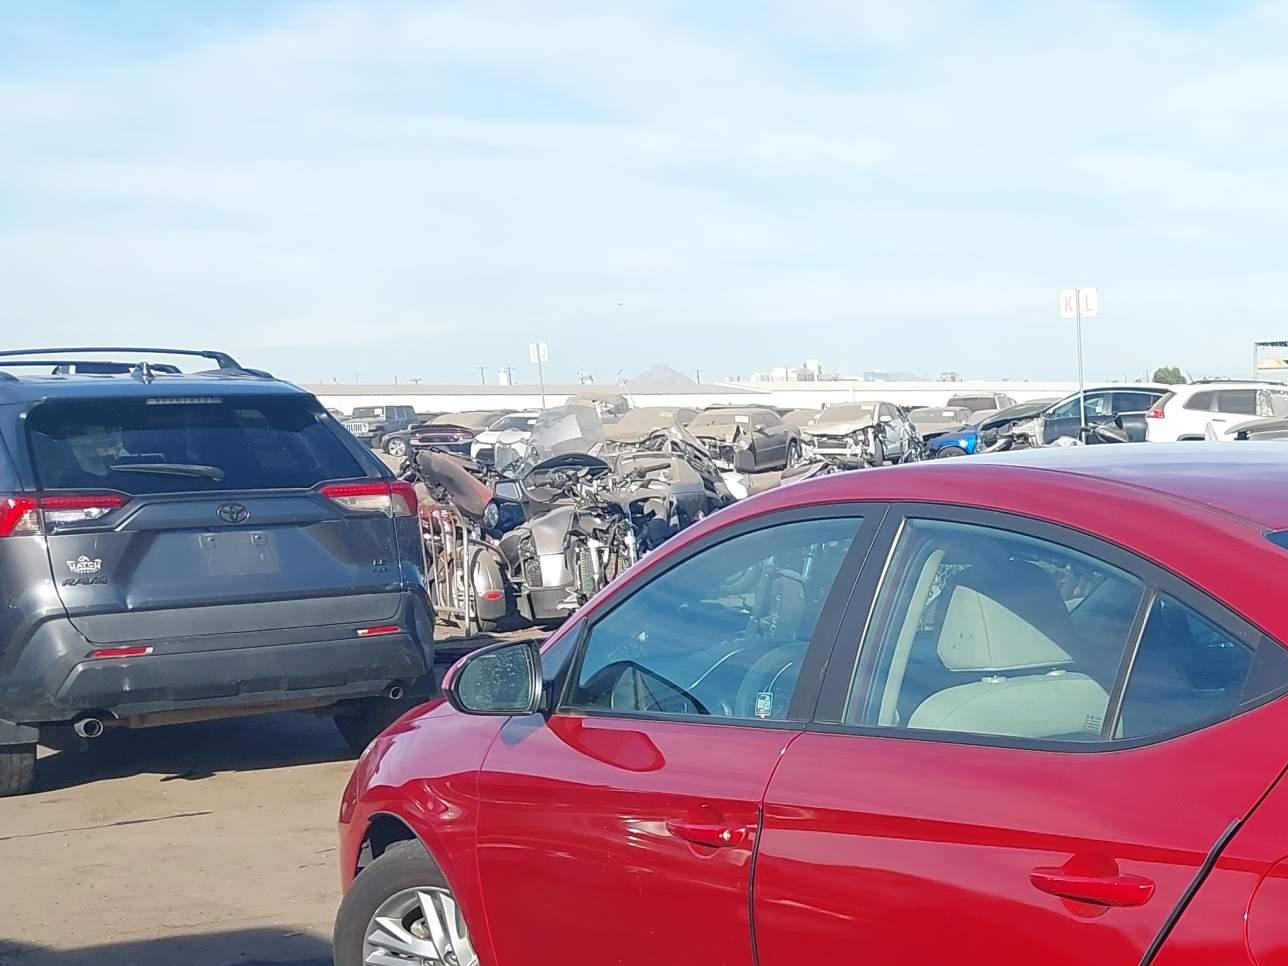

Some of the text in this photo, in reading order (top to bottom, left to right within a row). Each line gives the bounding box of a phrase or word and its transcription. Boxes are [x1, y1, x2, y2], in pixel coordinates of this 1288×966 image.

[1064, 294, 1074, 313] K
[1084, 294, 1094, 312] L
[66, 559, 102, 572] HATCH
[61, 575, 109, 587] RAV4
